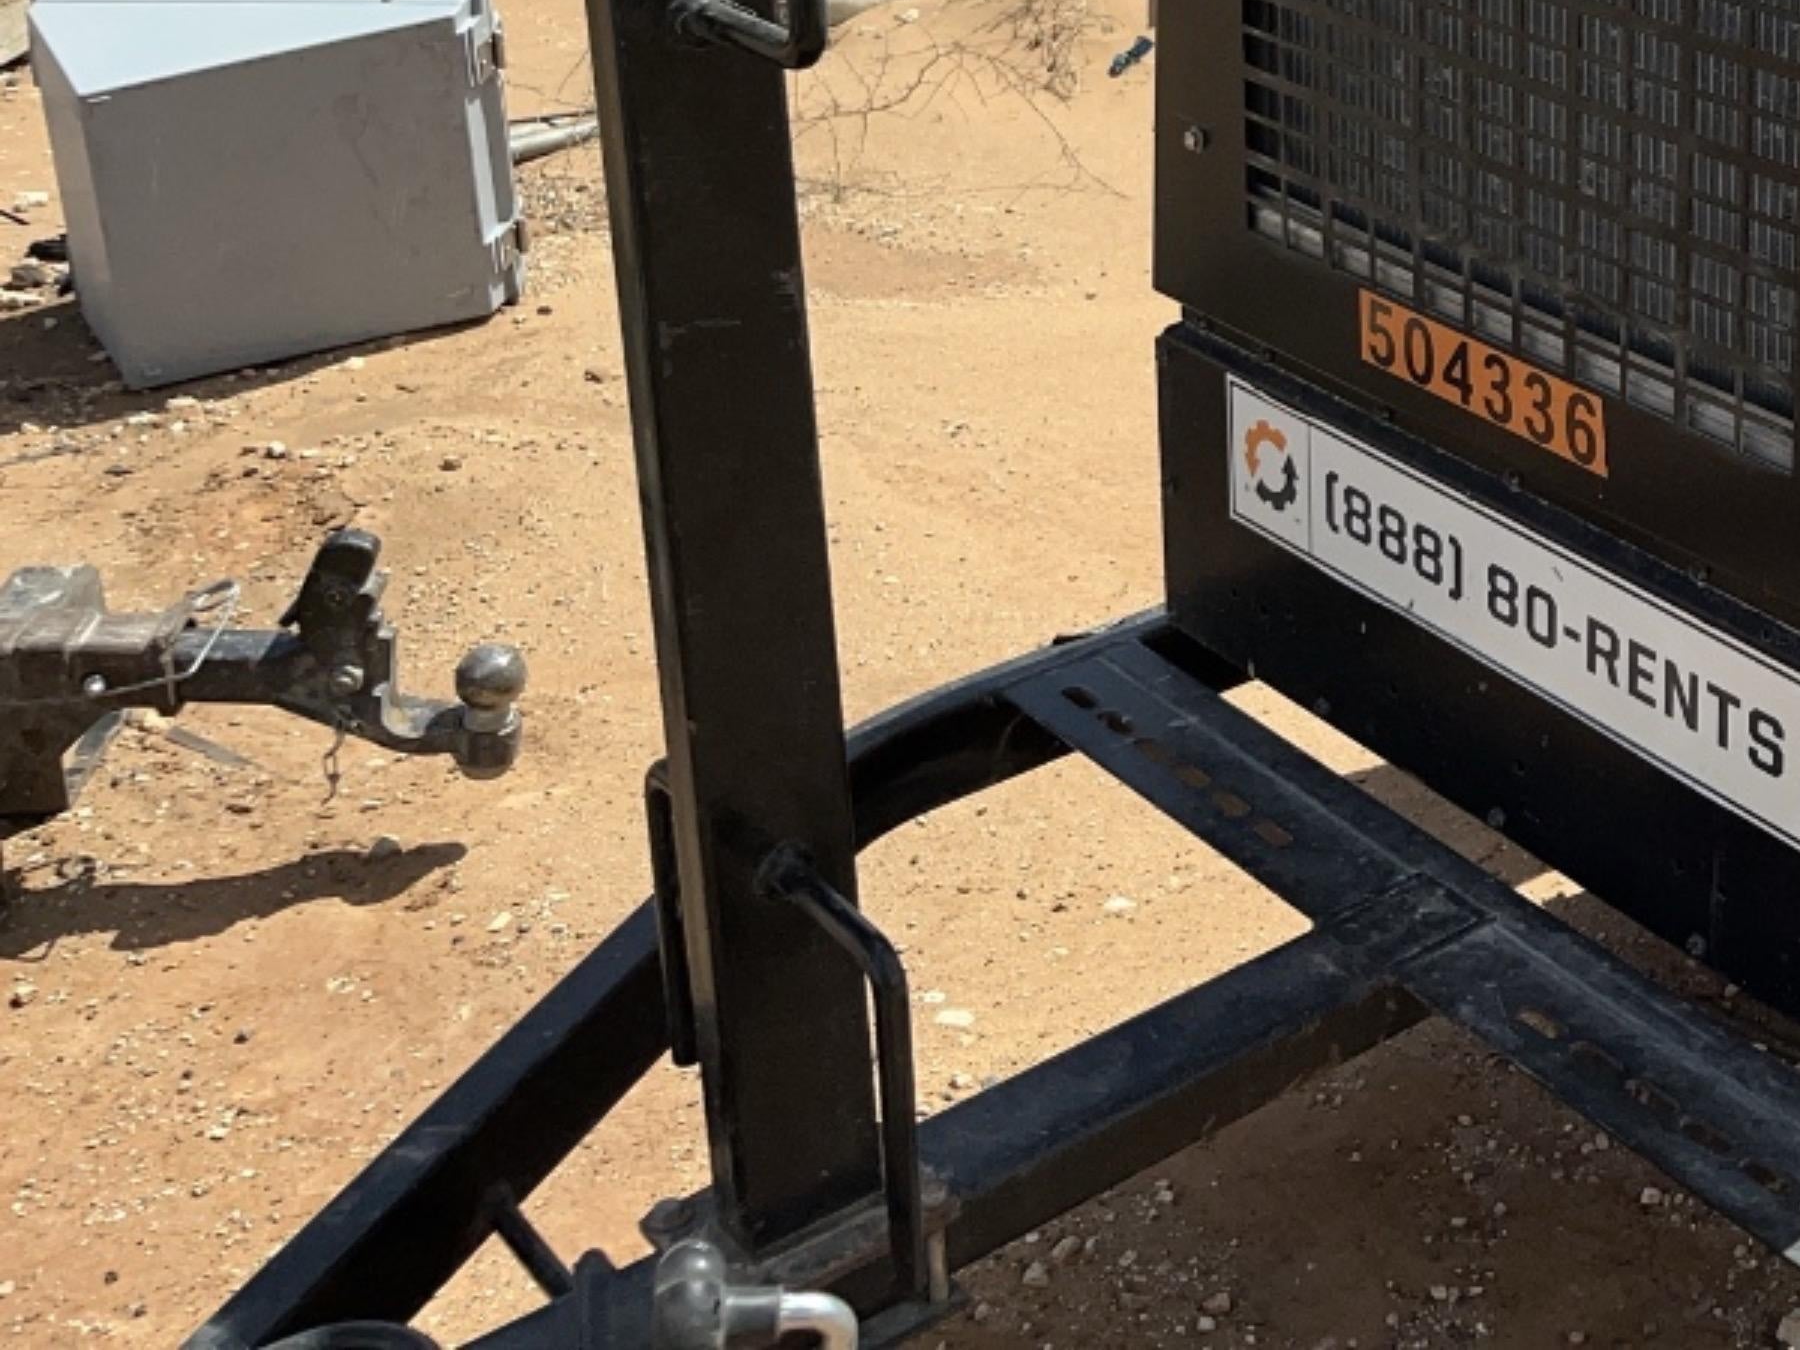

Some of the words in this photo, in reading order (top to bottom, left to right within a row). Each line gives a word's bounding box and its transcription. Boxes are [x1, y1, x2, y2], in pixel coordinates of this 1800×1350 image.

[1366, 300, 1598, 466] 504336
[1324, 470, 1464, 602] (888)
[1487, 564, 1786, 779] 80-RENTS
